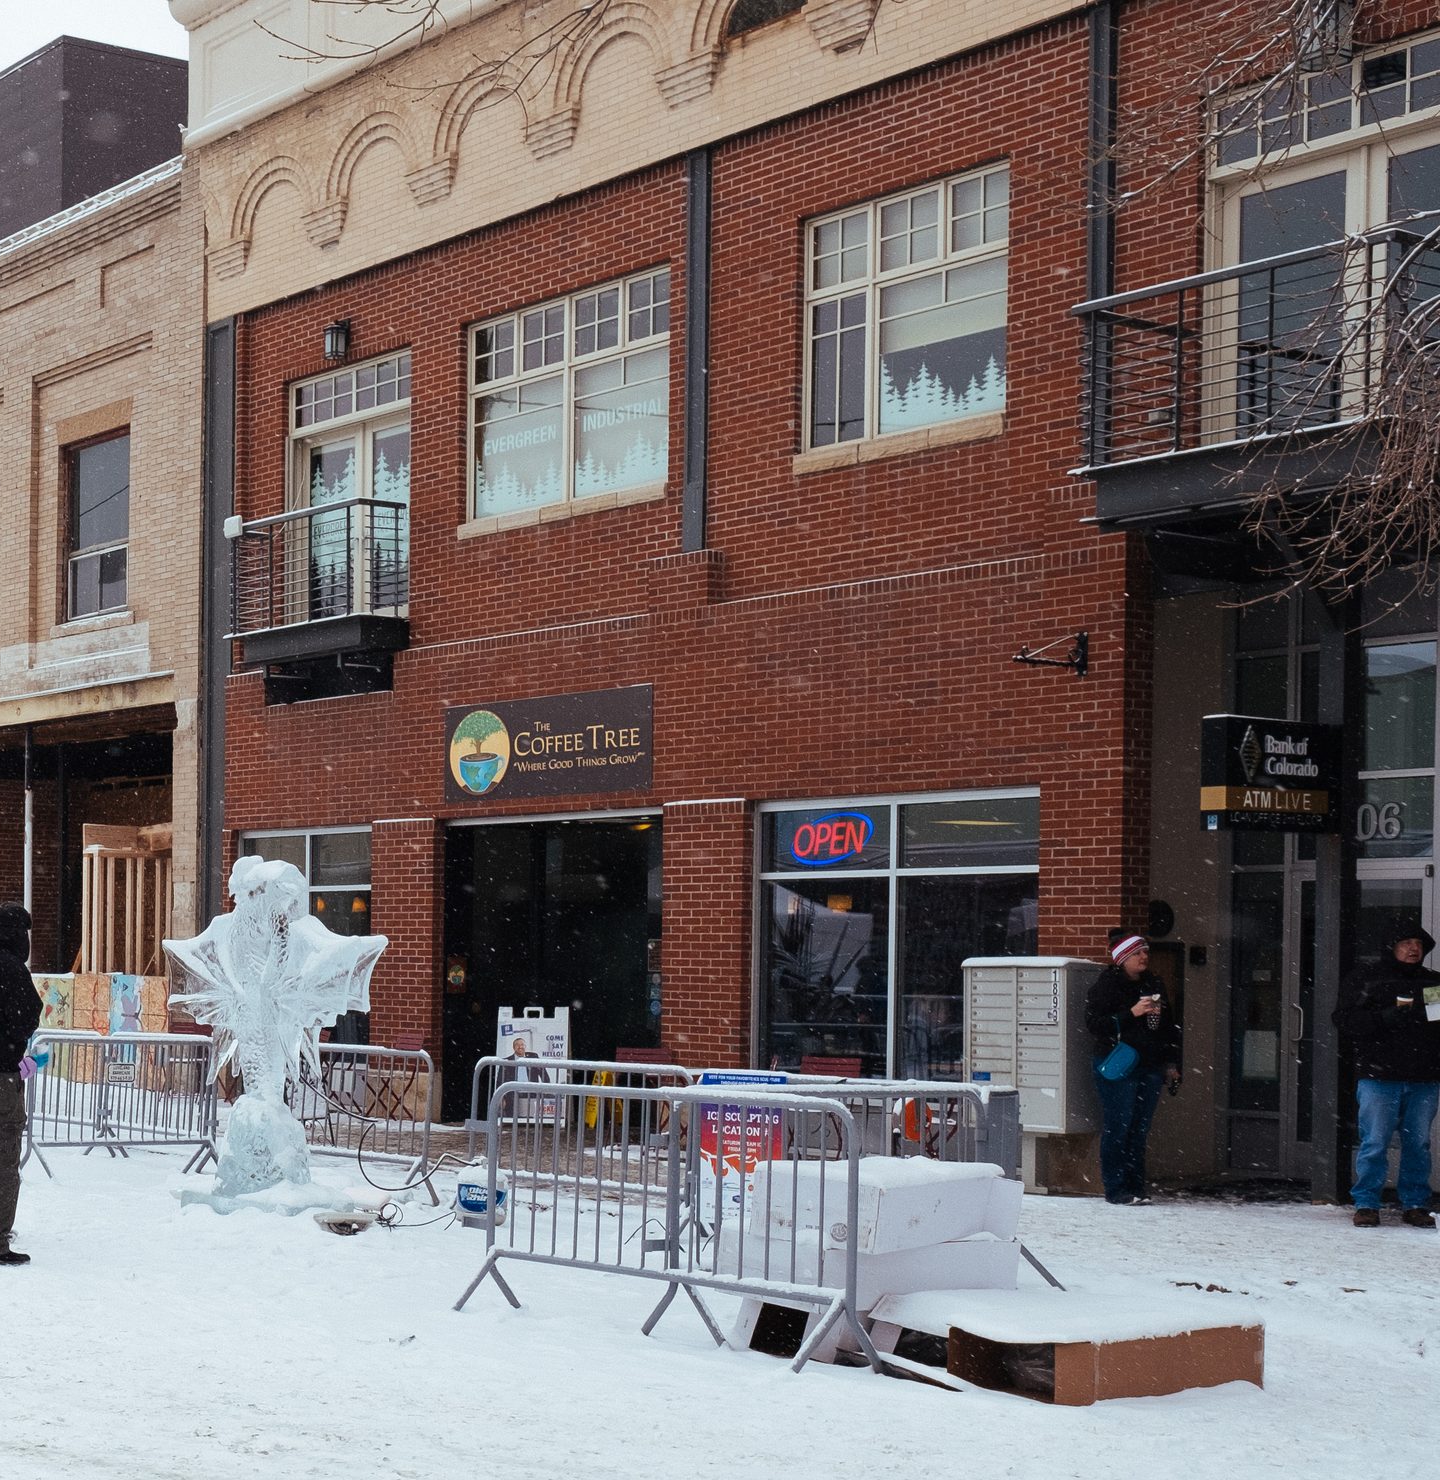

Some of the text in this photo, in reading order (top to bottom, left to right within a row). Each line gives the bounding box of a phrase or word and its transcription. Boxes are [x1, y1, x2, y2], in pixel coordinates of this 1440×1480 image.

[484, 399, 665, 457] EVERGREEN INDUSTRIAL
[534, 721, 551, 732] THE
[514, 724, 641, 757] COFFEE TREE
[1264, 734, 1309, 756] Bank of
[548, 759, 574, 770] GOOD
[575, 756, 607, 768] THINGS
[1265, 757, 1319, 777] Colorado
[1243, 790, 1312, 811] ATM LIVE
[1357, 802, 1401, 841] 06
[793, 820, 866, 857] OPEN
[712, 1124, 760, 1137] LCATON
